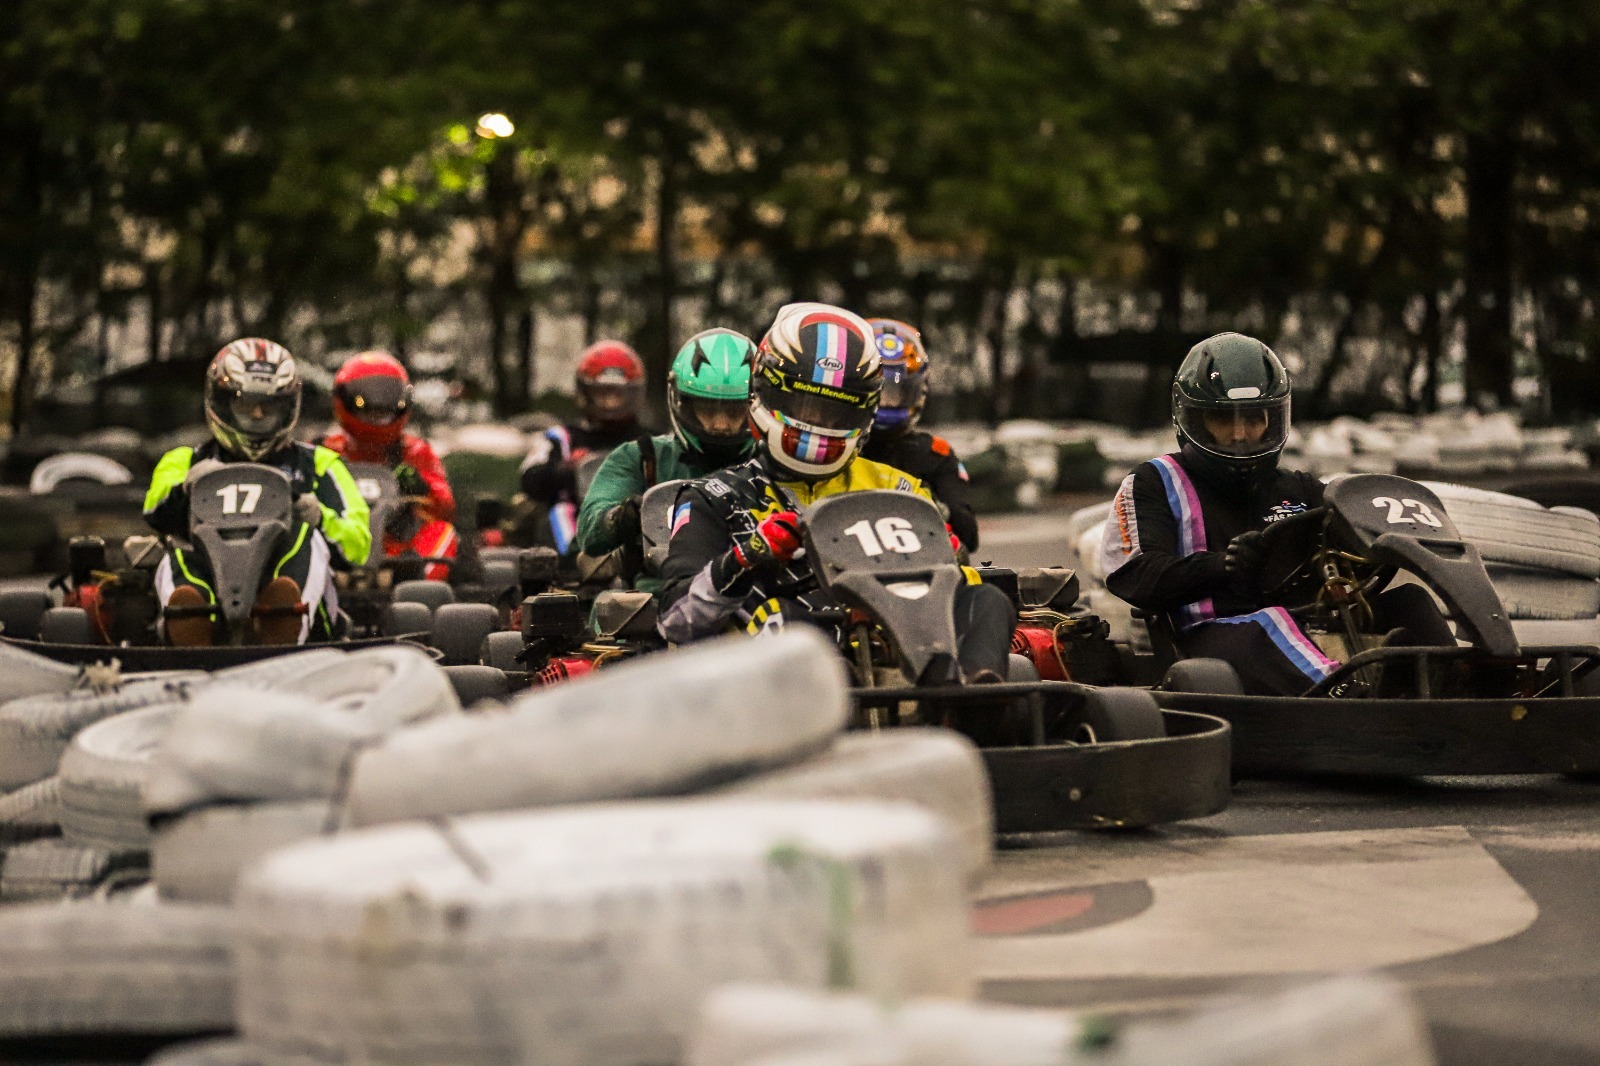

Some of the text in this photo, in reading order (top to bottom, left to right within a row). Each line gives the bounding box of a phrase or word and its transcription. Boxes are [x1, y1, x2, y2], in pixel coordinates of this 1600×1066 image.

[793, 382, 820, 394] Michel
[216, 484, 262, 514] 17
[1372, 497, 1442, 527] 23
[844, 517, 921, 557] 16
